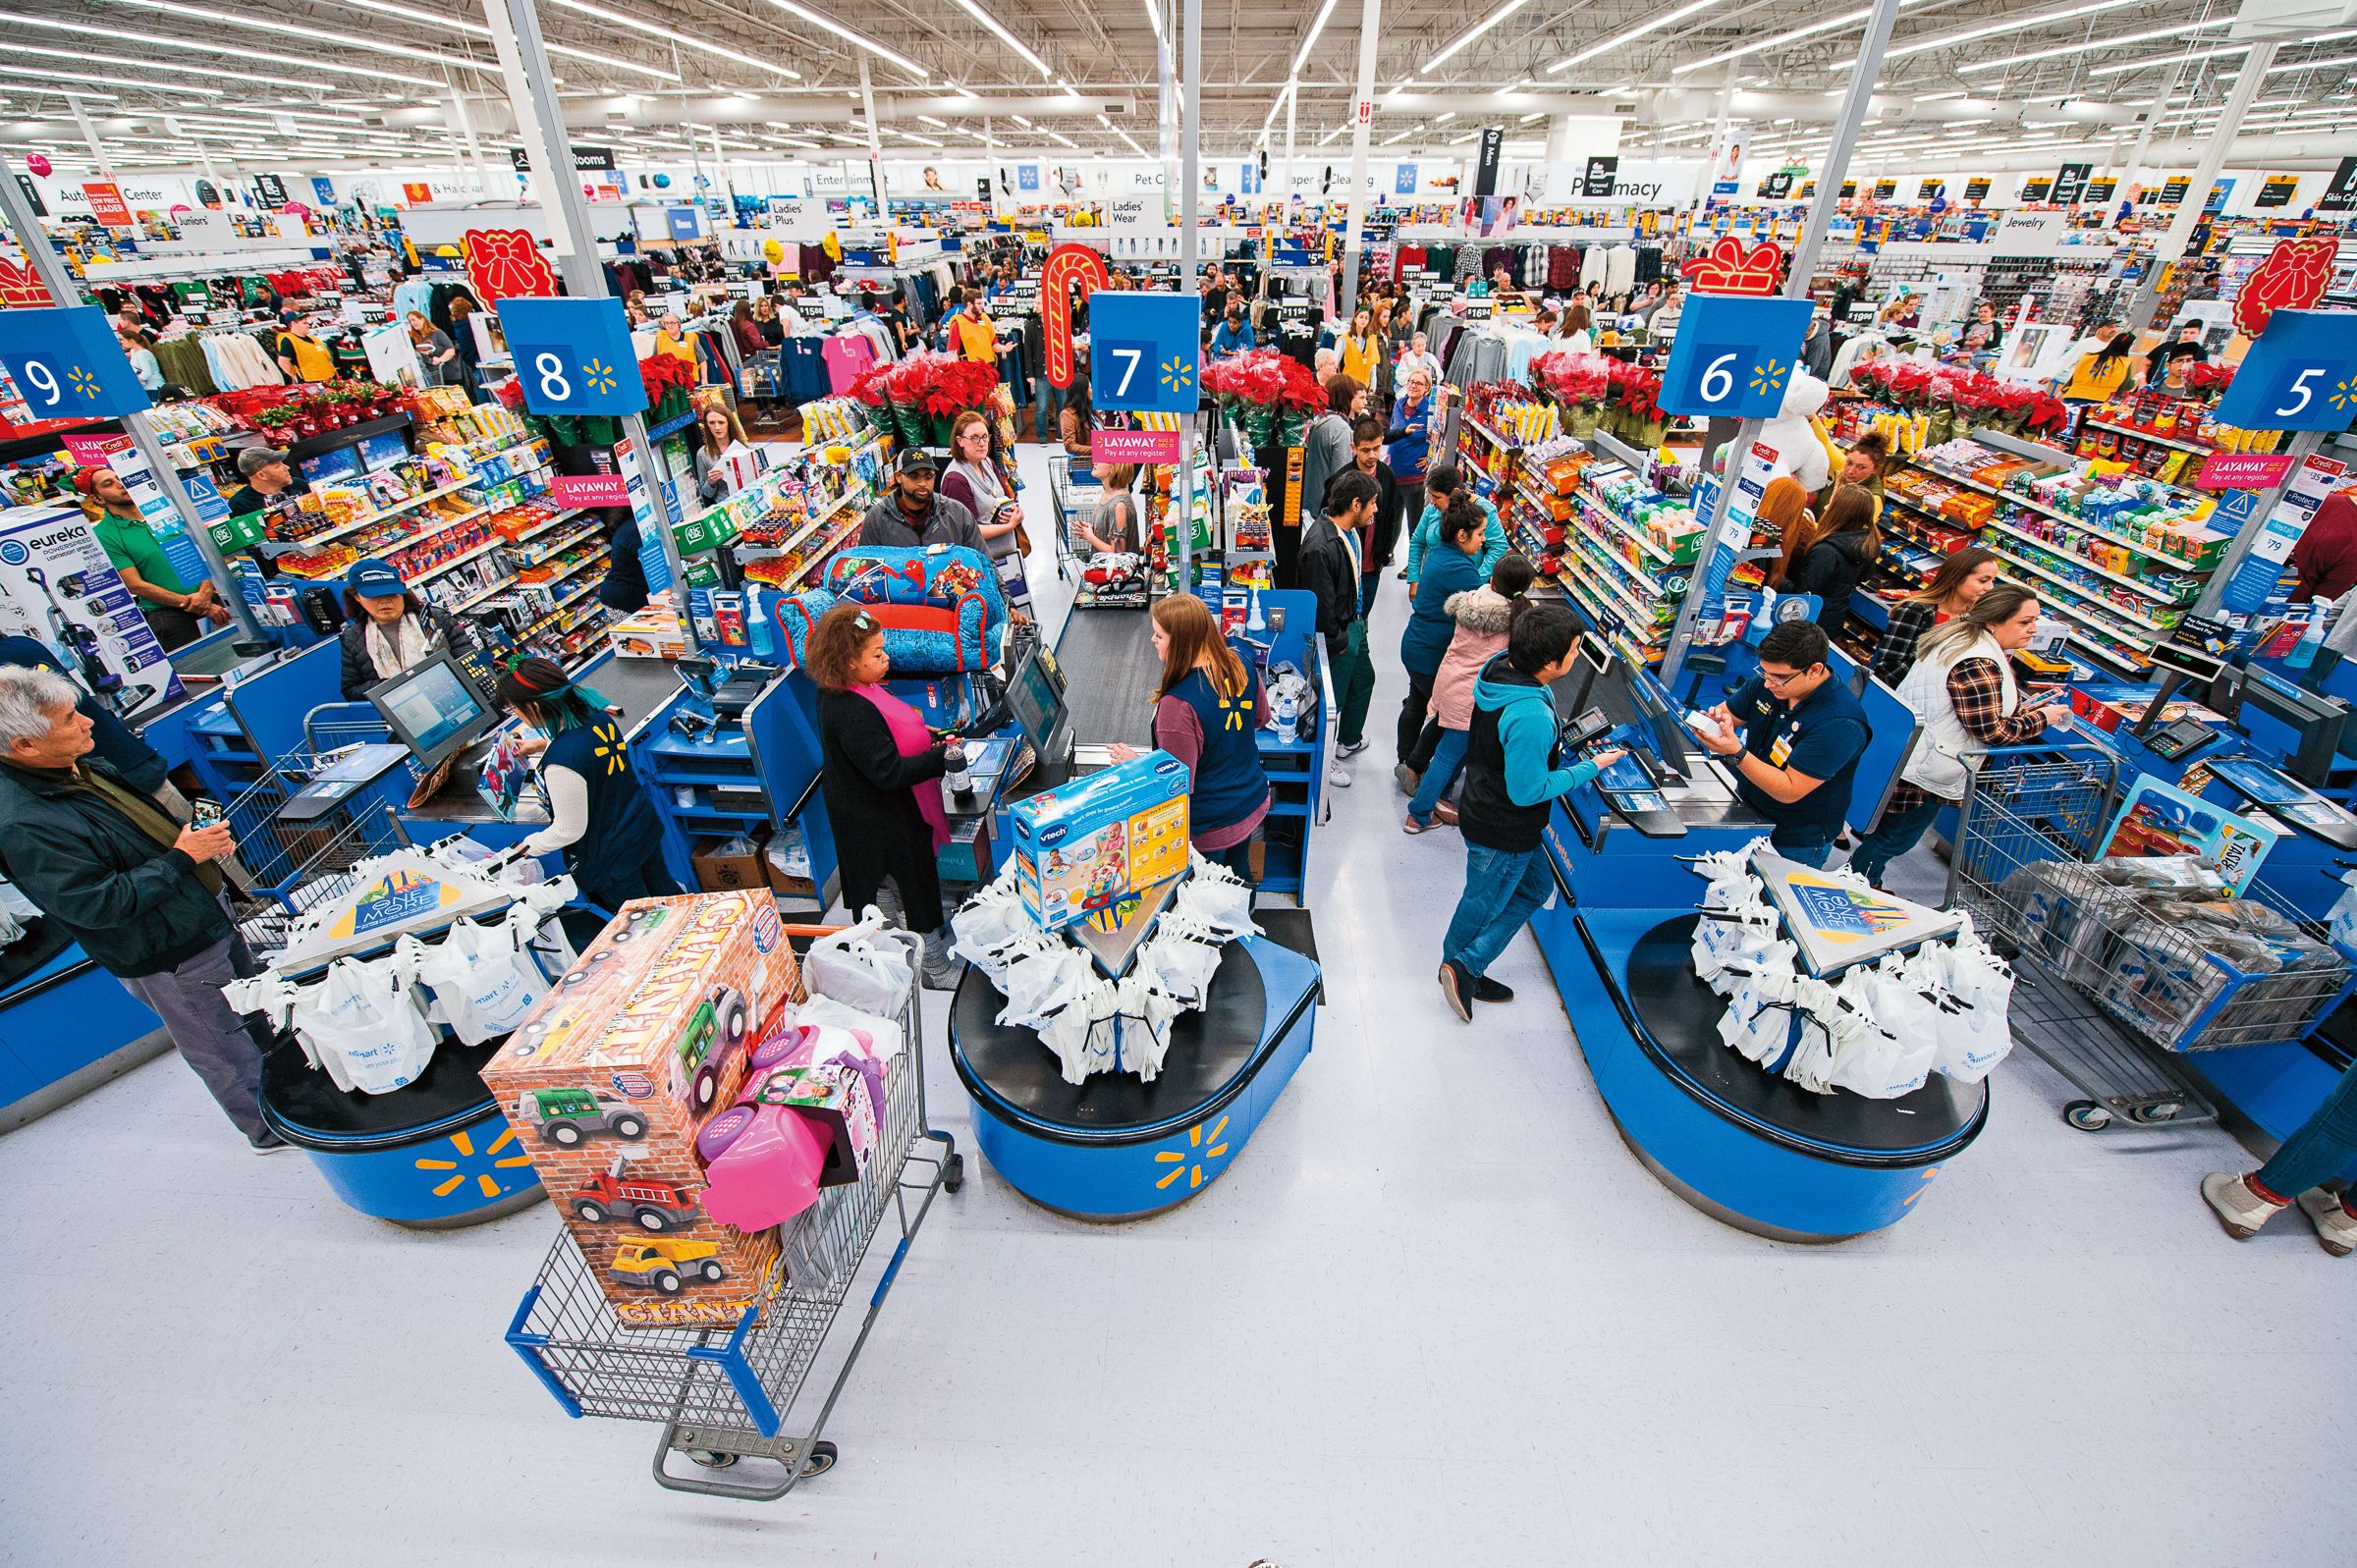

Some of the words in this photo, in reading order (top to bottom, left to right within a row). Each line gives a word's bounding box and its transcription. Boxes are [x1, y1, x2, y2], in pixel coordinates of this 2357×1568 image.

[1486, 147, 1495, 166] Men
[1135, 174, 1151, 185] Pet
[124, 189, 162, 200] Center
[1571, 178, 1662, 201] Pmacy
[773, 204, 801, 213] Ladies'
[1113, 201, 1143, 211] Ladies'
[180, 216, 208, 226] Juniors'
[775, 215, 794, 225] Plus
[1113, 213, 1136, 223] Wear
[2005, 217, 2046, 231] Jewelry
[535, 352, 572, 401] 8
[1113, 350, 1141, 397] 7
[1700, 353, 1737, 403] 6
[25, 360, 61, 405] 9
[2275, 368, 2327, 417] 5
[76, 441, 105, 451] LAYA
[105, 441, 125, 451] Credit
[1104, 438, 1156, 448] LAYAWAY
[1756, 444, 1771, 456] Credit
[2216, 462, 2268, 472] LAYAWAY
[2312, 458, 2332, 468] Credit
[565, 481, 618, 494] LAYAWAY
[1743, 480, 1761, 494] Protect
[605, 493, 630, 502] registe
[2292, 493, 2315, 507] Protect
[2274, 522, 2295, 534] Install
[29, 526, 87, 551] eureka
[43, 537, 92, 555] POWERSPEED
[1097, 593, 1143, 602] Sharpie
[2183, 622, 2203, 632] Walmart
[2198, 620, 2212, 628] faster
[1156, 762, 1179, 774] vtech
[1015, 822, 1029, 836] vtech
[1040, 825, 1068, 842] vtech
[2221, 842, 2246, 873] TASTY
[373, 889, 422, 910] ONE
[363, 894, 430, 923] MORE
[1811, 889, 1847, 928] MORE
[1831, 895, 1861, 927] ONE
[597, 896, 746, 1057] GIANT
[618, 1301, 753, 1323] GIANT
